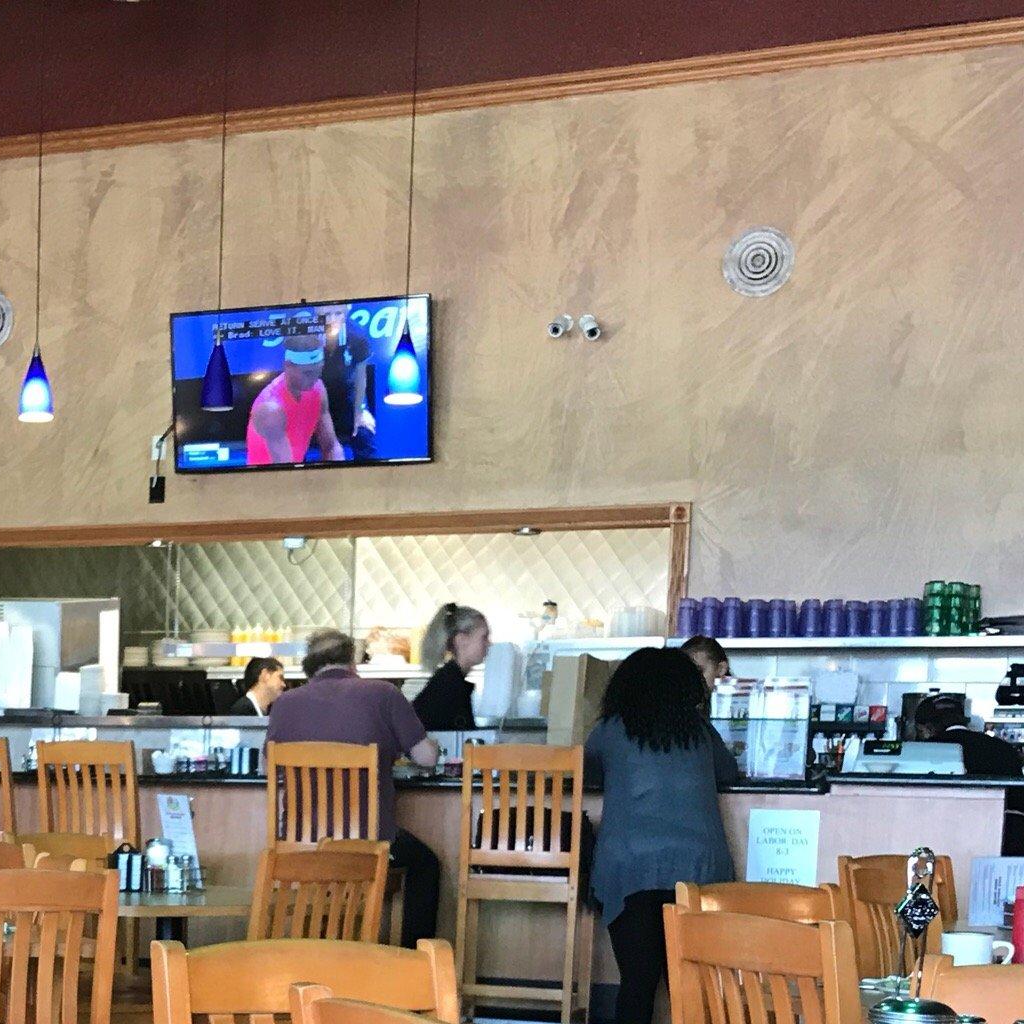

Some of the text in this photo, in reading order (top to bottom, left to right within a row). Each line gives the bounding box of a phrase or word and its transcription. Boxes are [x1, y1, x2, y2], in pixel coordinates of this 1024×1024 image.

[259, 329, 281, 337] LOVE
[762, 827, 802, 835] OPEN ON
[756, 837, 809, 846] LABOR DAY
[766, 867, 796, 875] HAPPY
